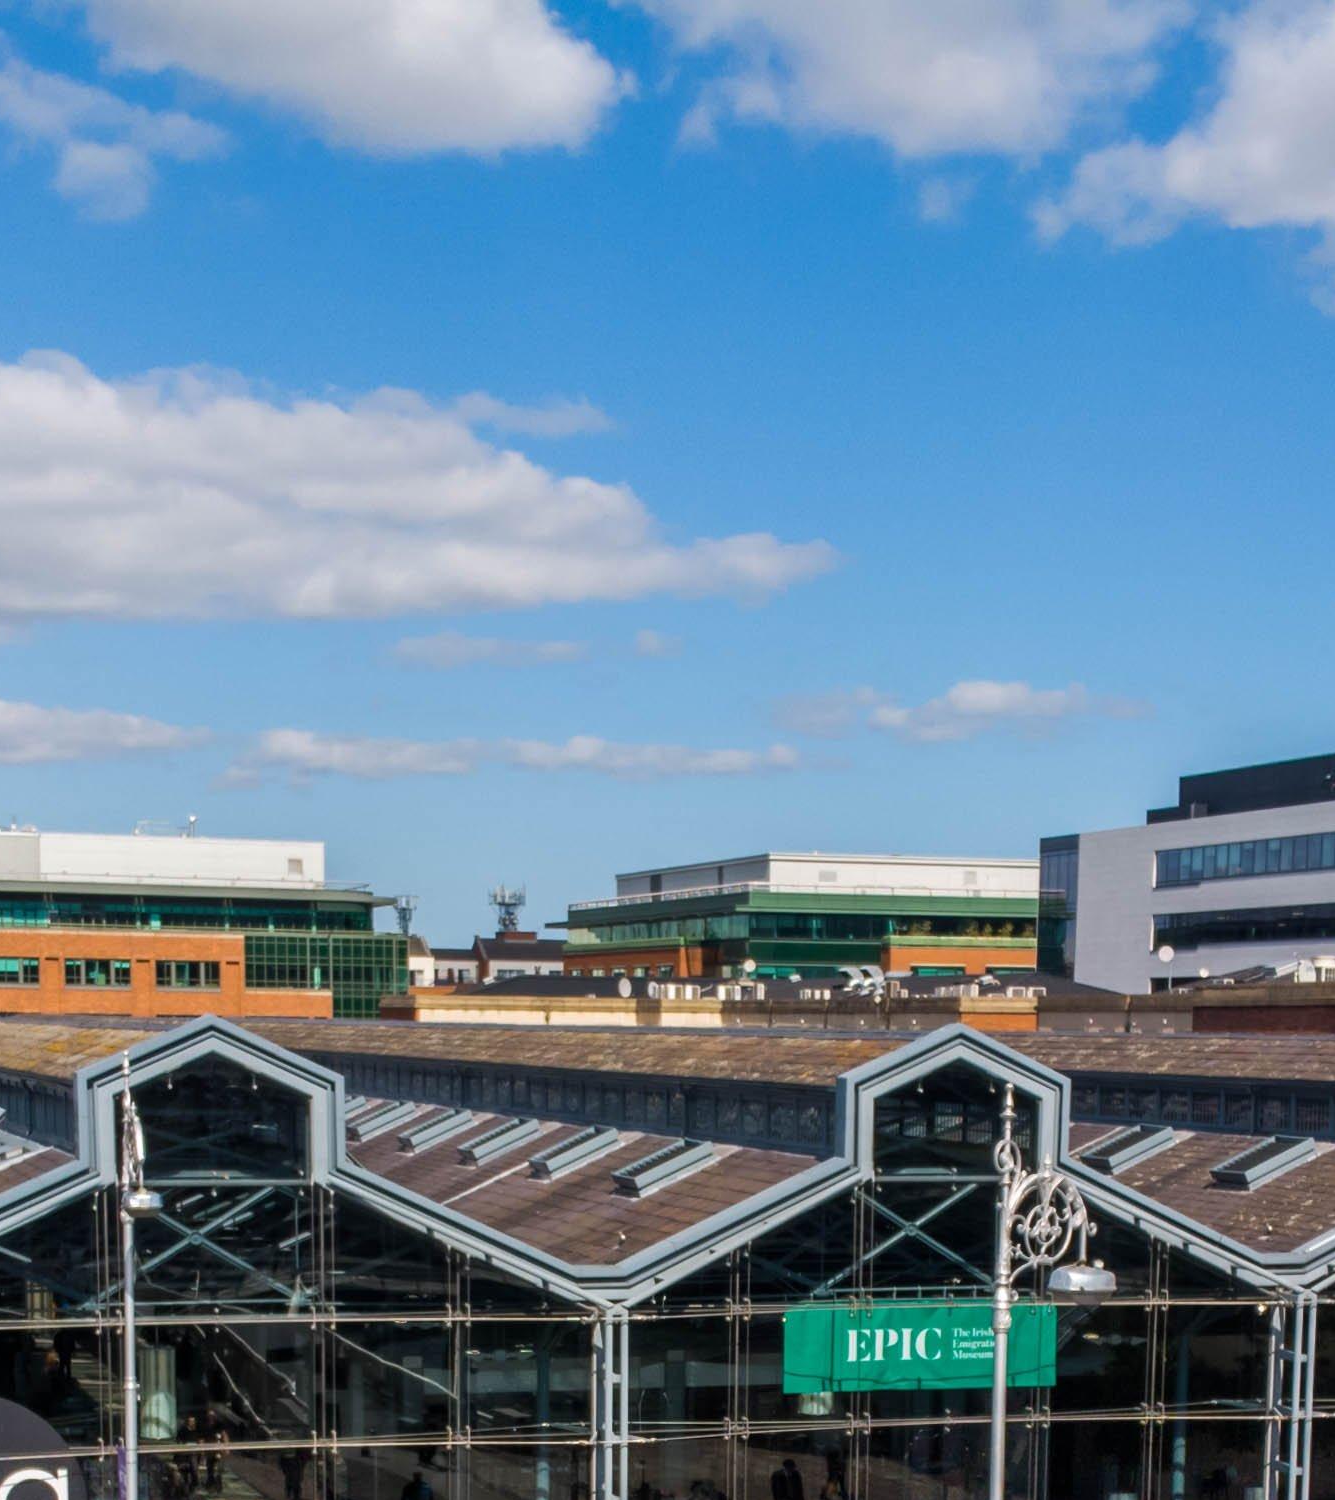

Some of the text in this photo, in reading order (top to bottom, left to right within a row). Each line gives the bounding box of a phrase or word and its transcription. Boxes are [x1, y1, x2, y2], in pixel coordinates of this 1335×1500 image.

[953, 1328, 971, 1337] The
[846, 1327, 942, 1362] EPIC
[953, 1339, 996, 1350] Emigrati
